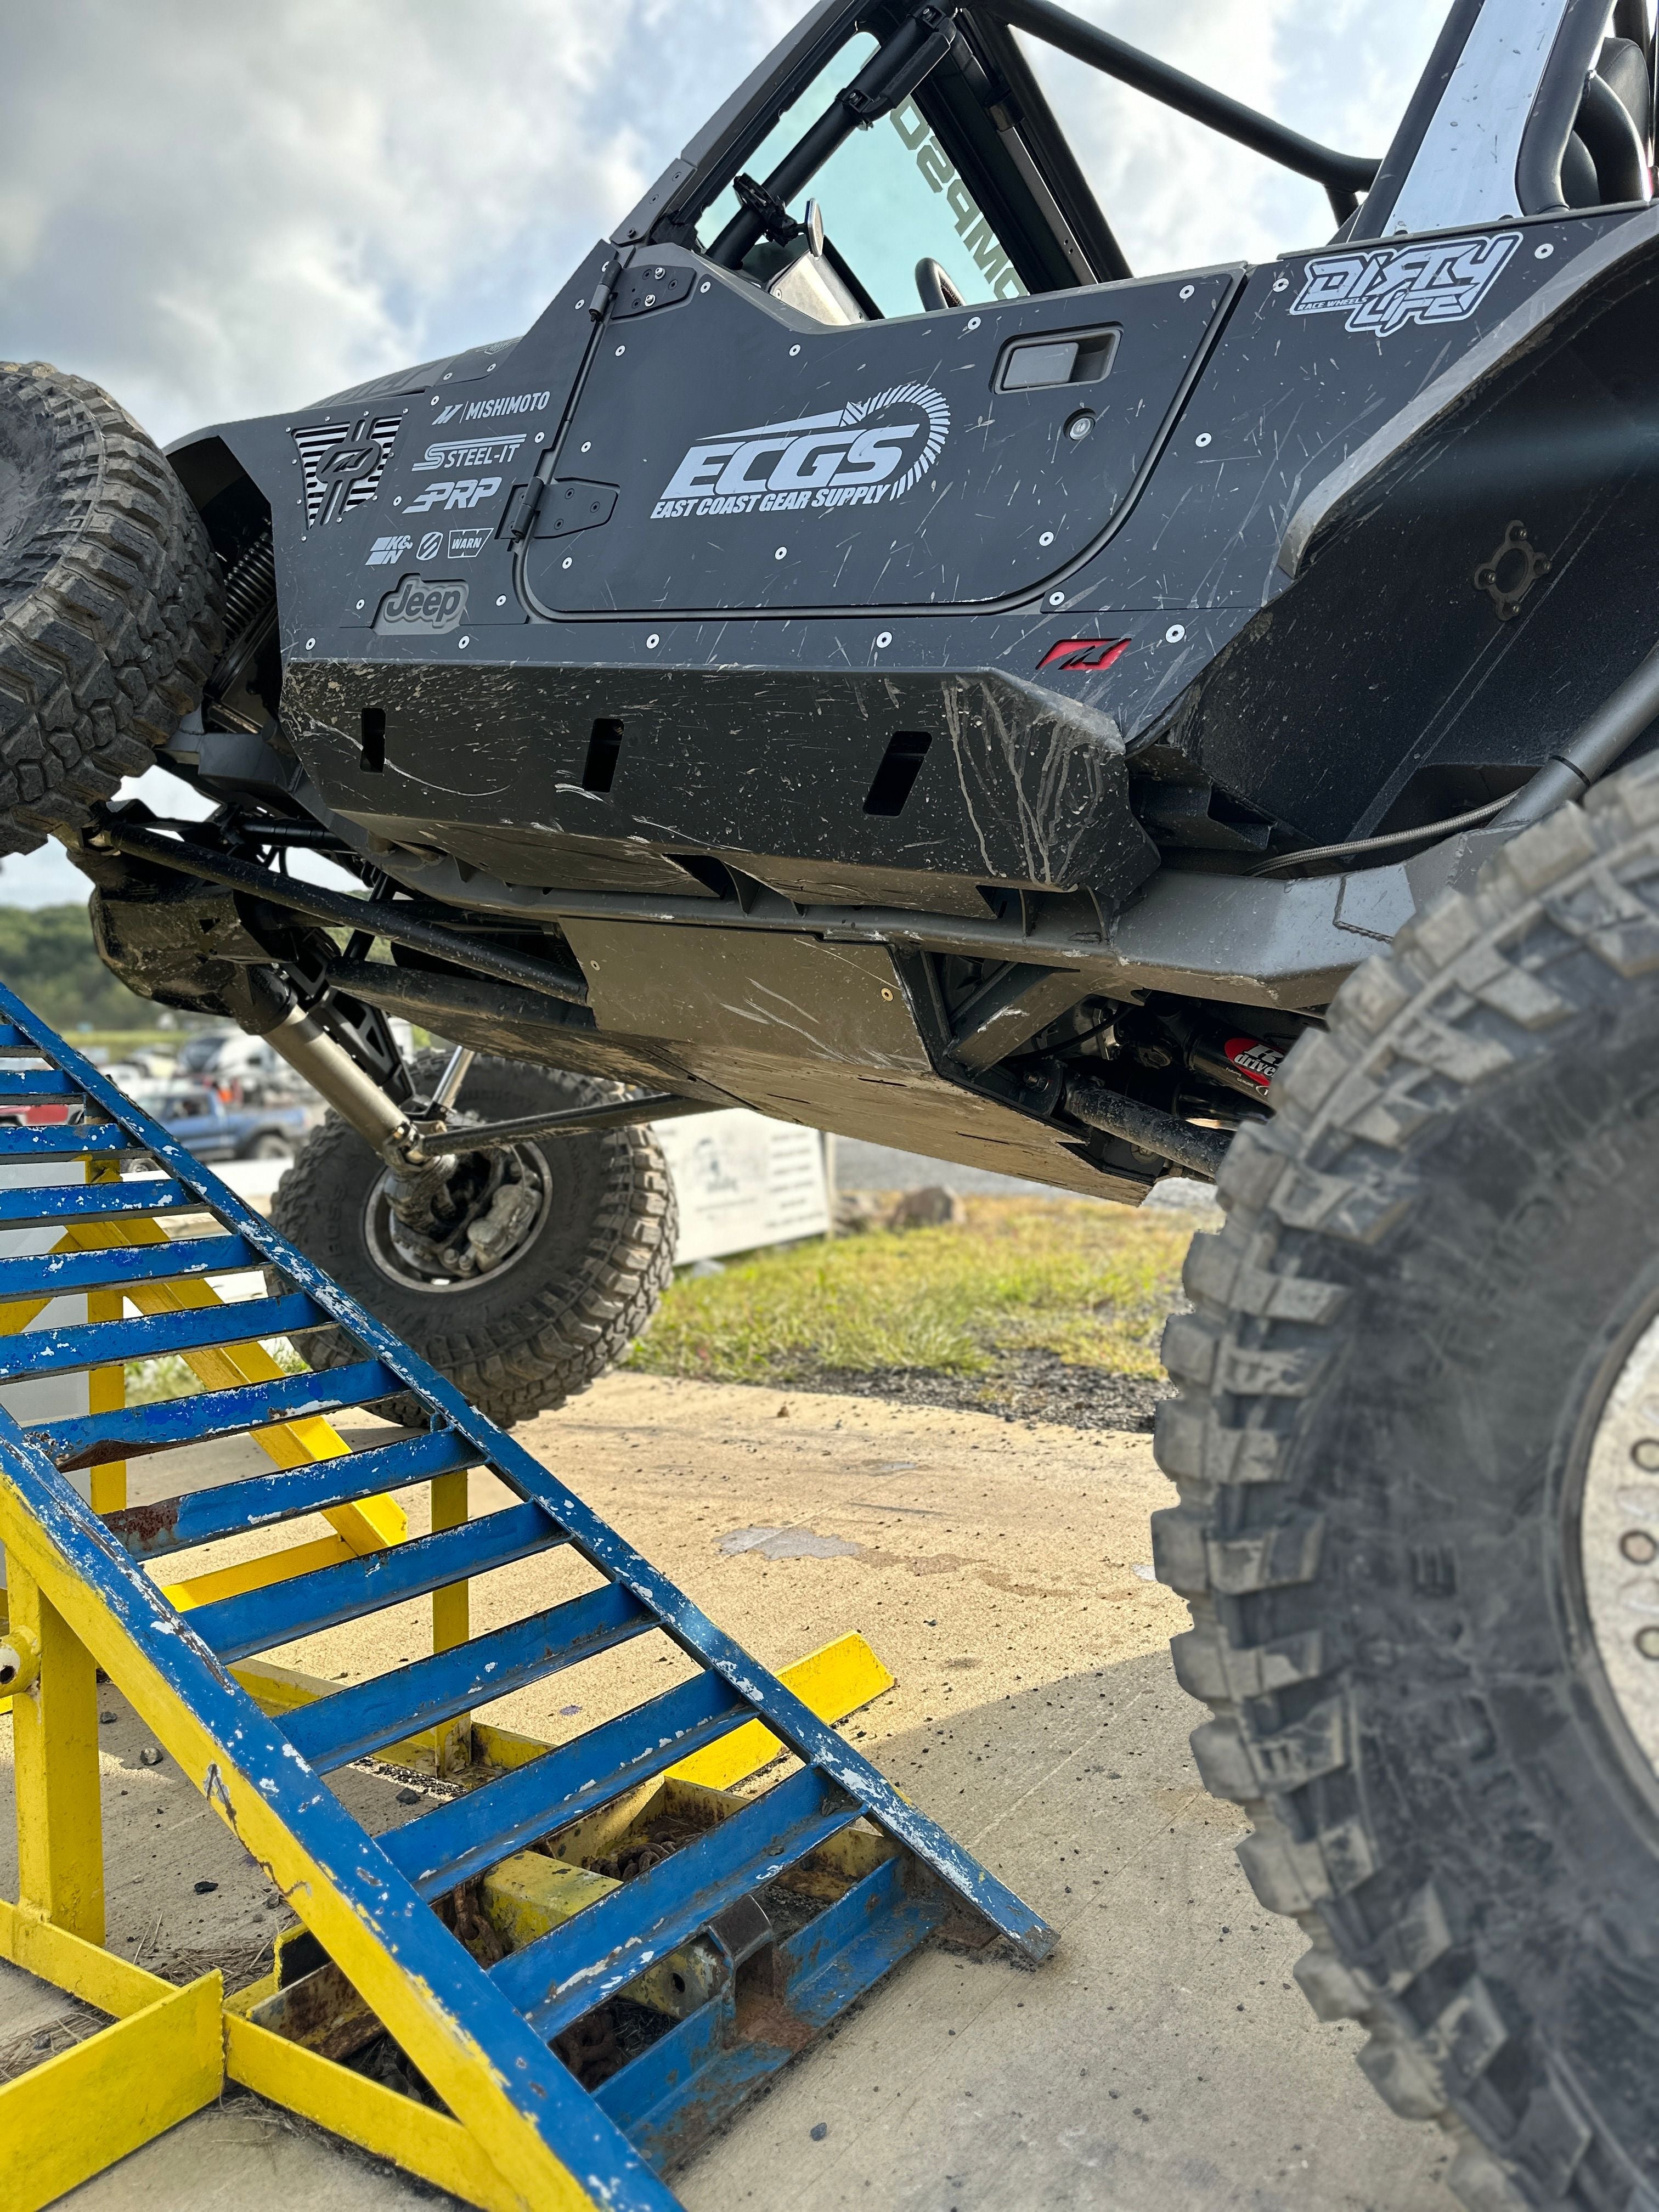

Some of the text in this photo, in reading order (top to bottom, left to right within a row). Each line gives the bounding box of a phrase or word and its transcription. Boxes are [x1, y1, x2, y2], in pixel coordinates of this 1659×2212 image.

[1304, 239, 1513, 303] DIRTY
[1297, 297, 1369, 311] RACE WHEELS
[1353, 284, 1480, 329] LIFE
[467, 391, 550, 420] MISHIMOTO
[660, 424, 920, 500] ECGS
[402, 477, 503, 514] PRP
[650, 483, 891, 519] EAST COAST GEAR SUPPLY
[451, 538, 482, 549] WARN
[386, 583, 461, 623] Jeep
